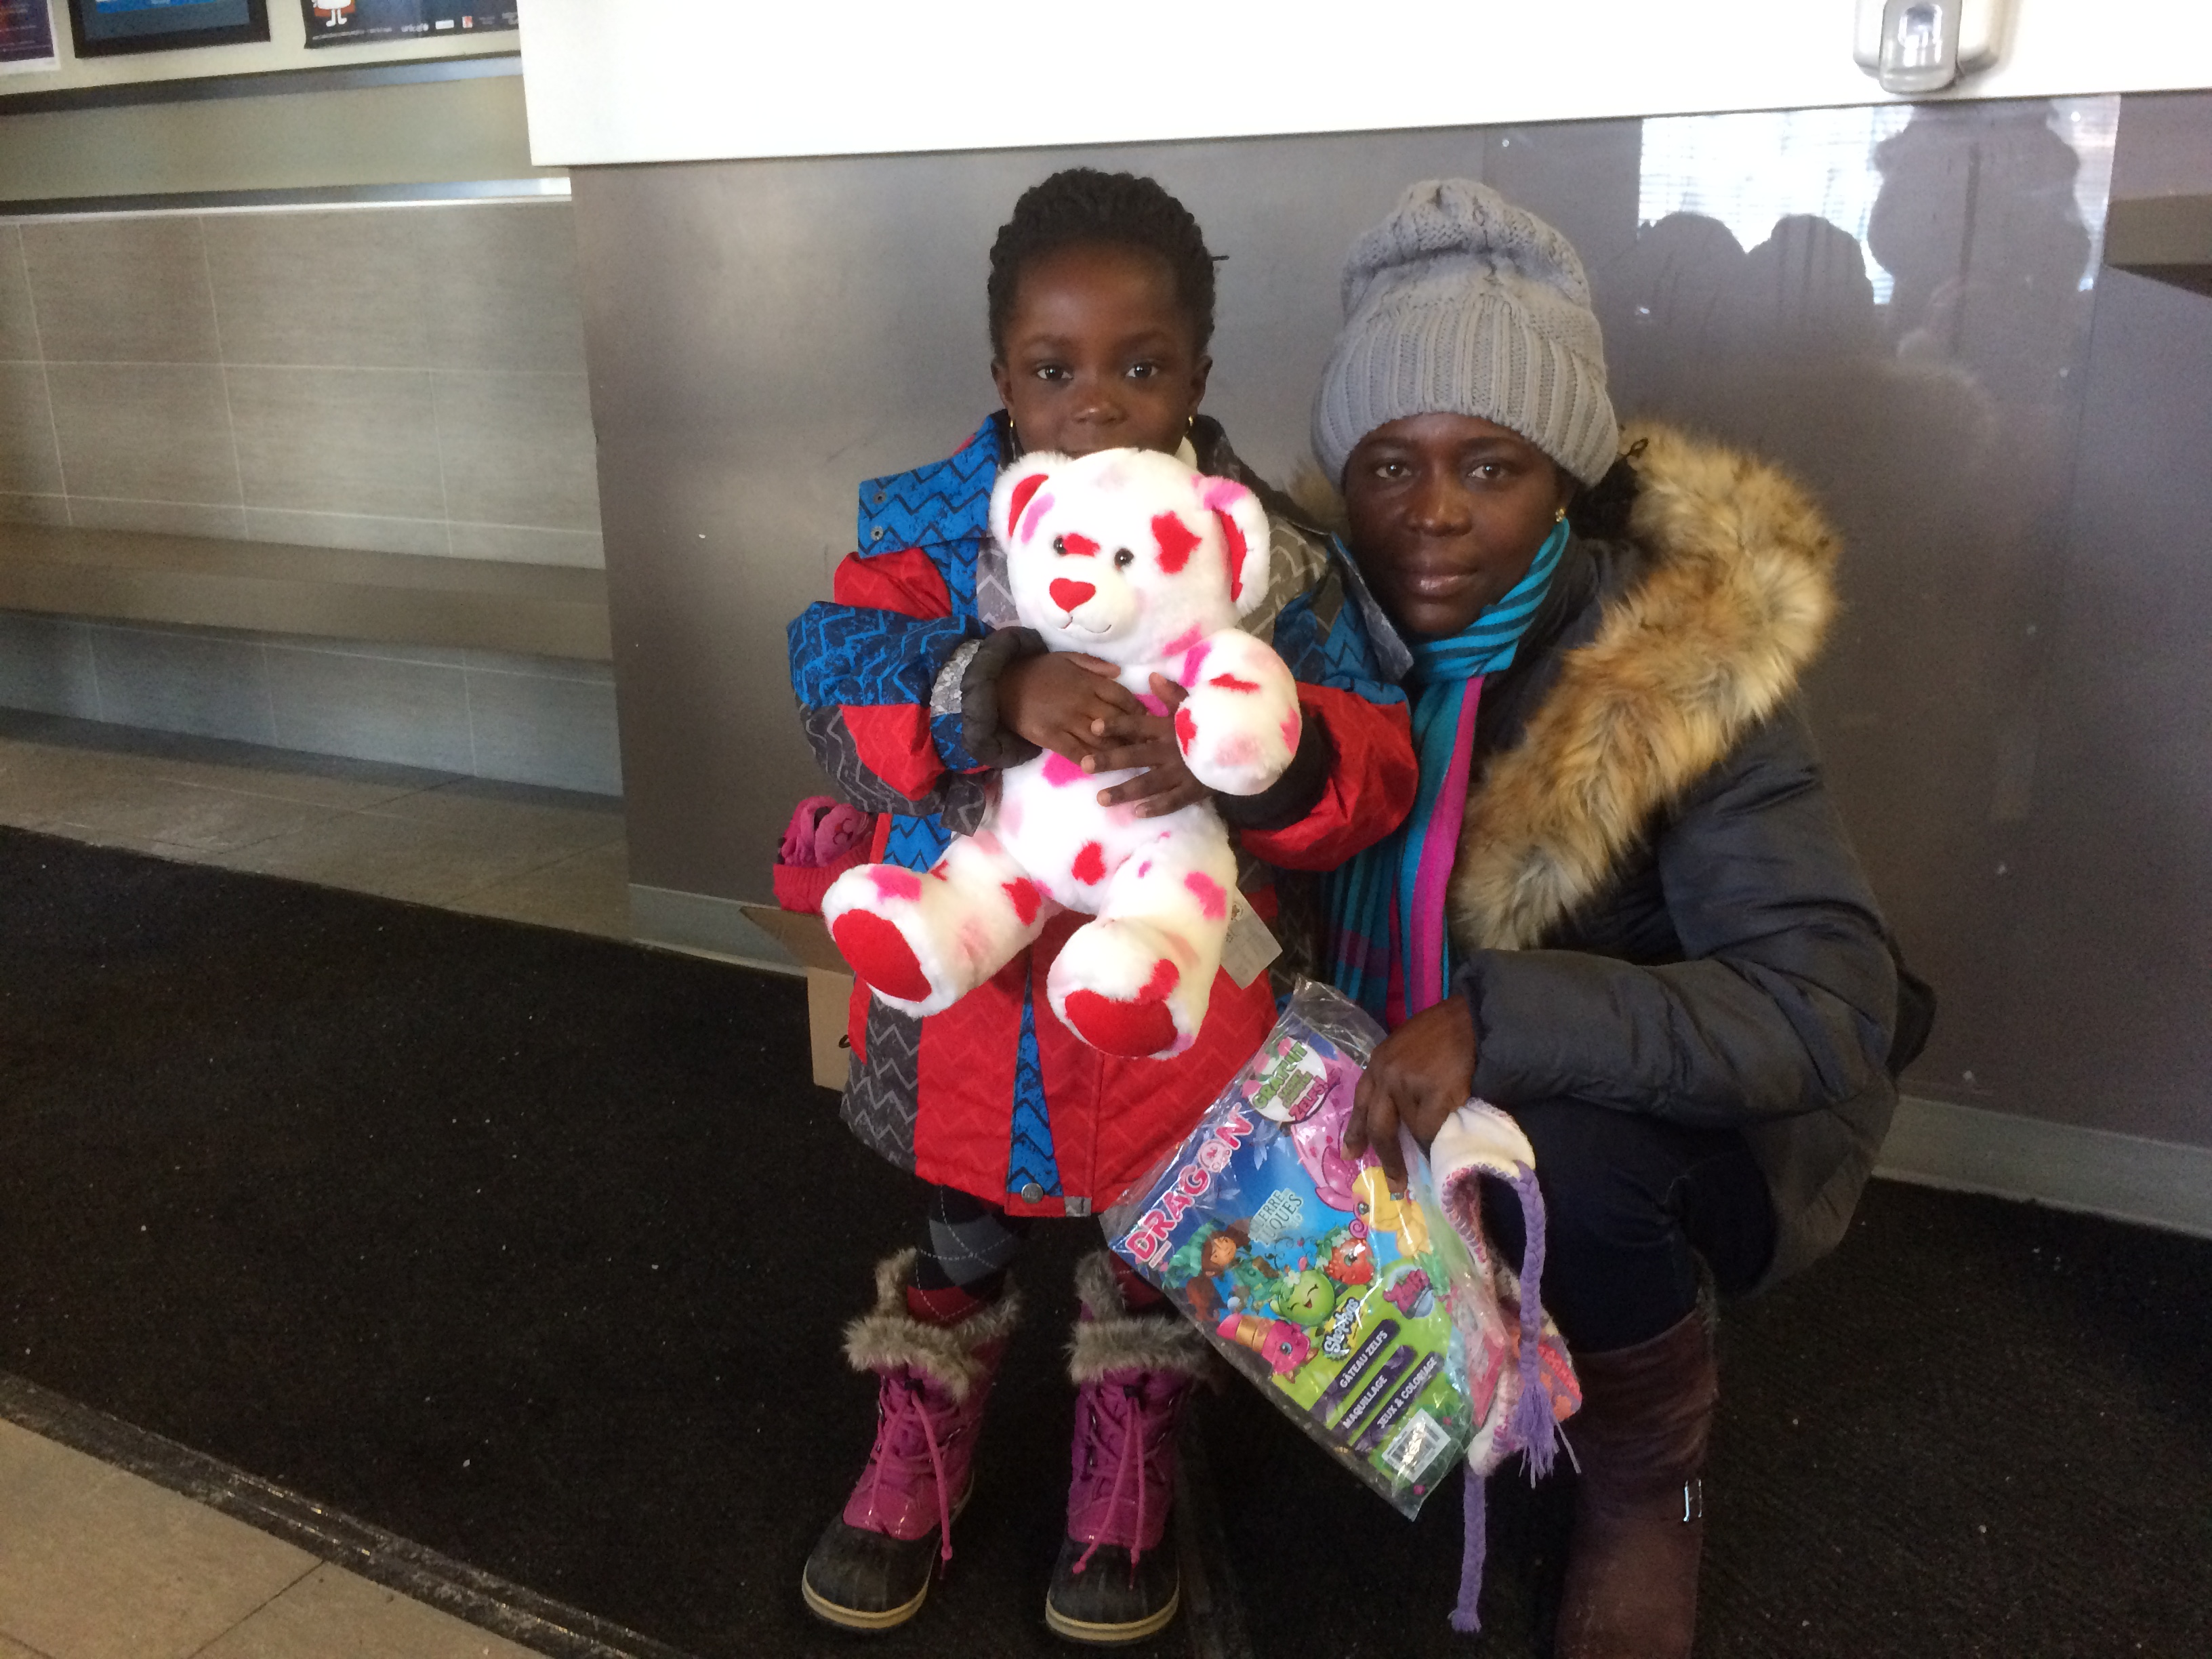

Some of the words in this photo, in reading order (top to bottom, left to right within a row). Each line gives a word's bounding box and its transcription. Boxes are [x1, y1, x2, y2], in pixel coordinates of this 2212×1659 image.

[1252, 1042, 1308, 1109] GRATUIT
[1339, 1353, 1369, 1389] GÂTEAU
[1365, 1330, 1388, 1356] ZELFS
[1343, 1374, 1387, 1429] MAQUILLAGE
[1377, 1405, 1397, 1429] JEUX
[1394, 1397, 1405, 1408] &
[1401, 1356, 1437, 1399] COLORIAGE
